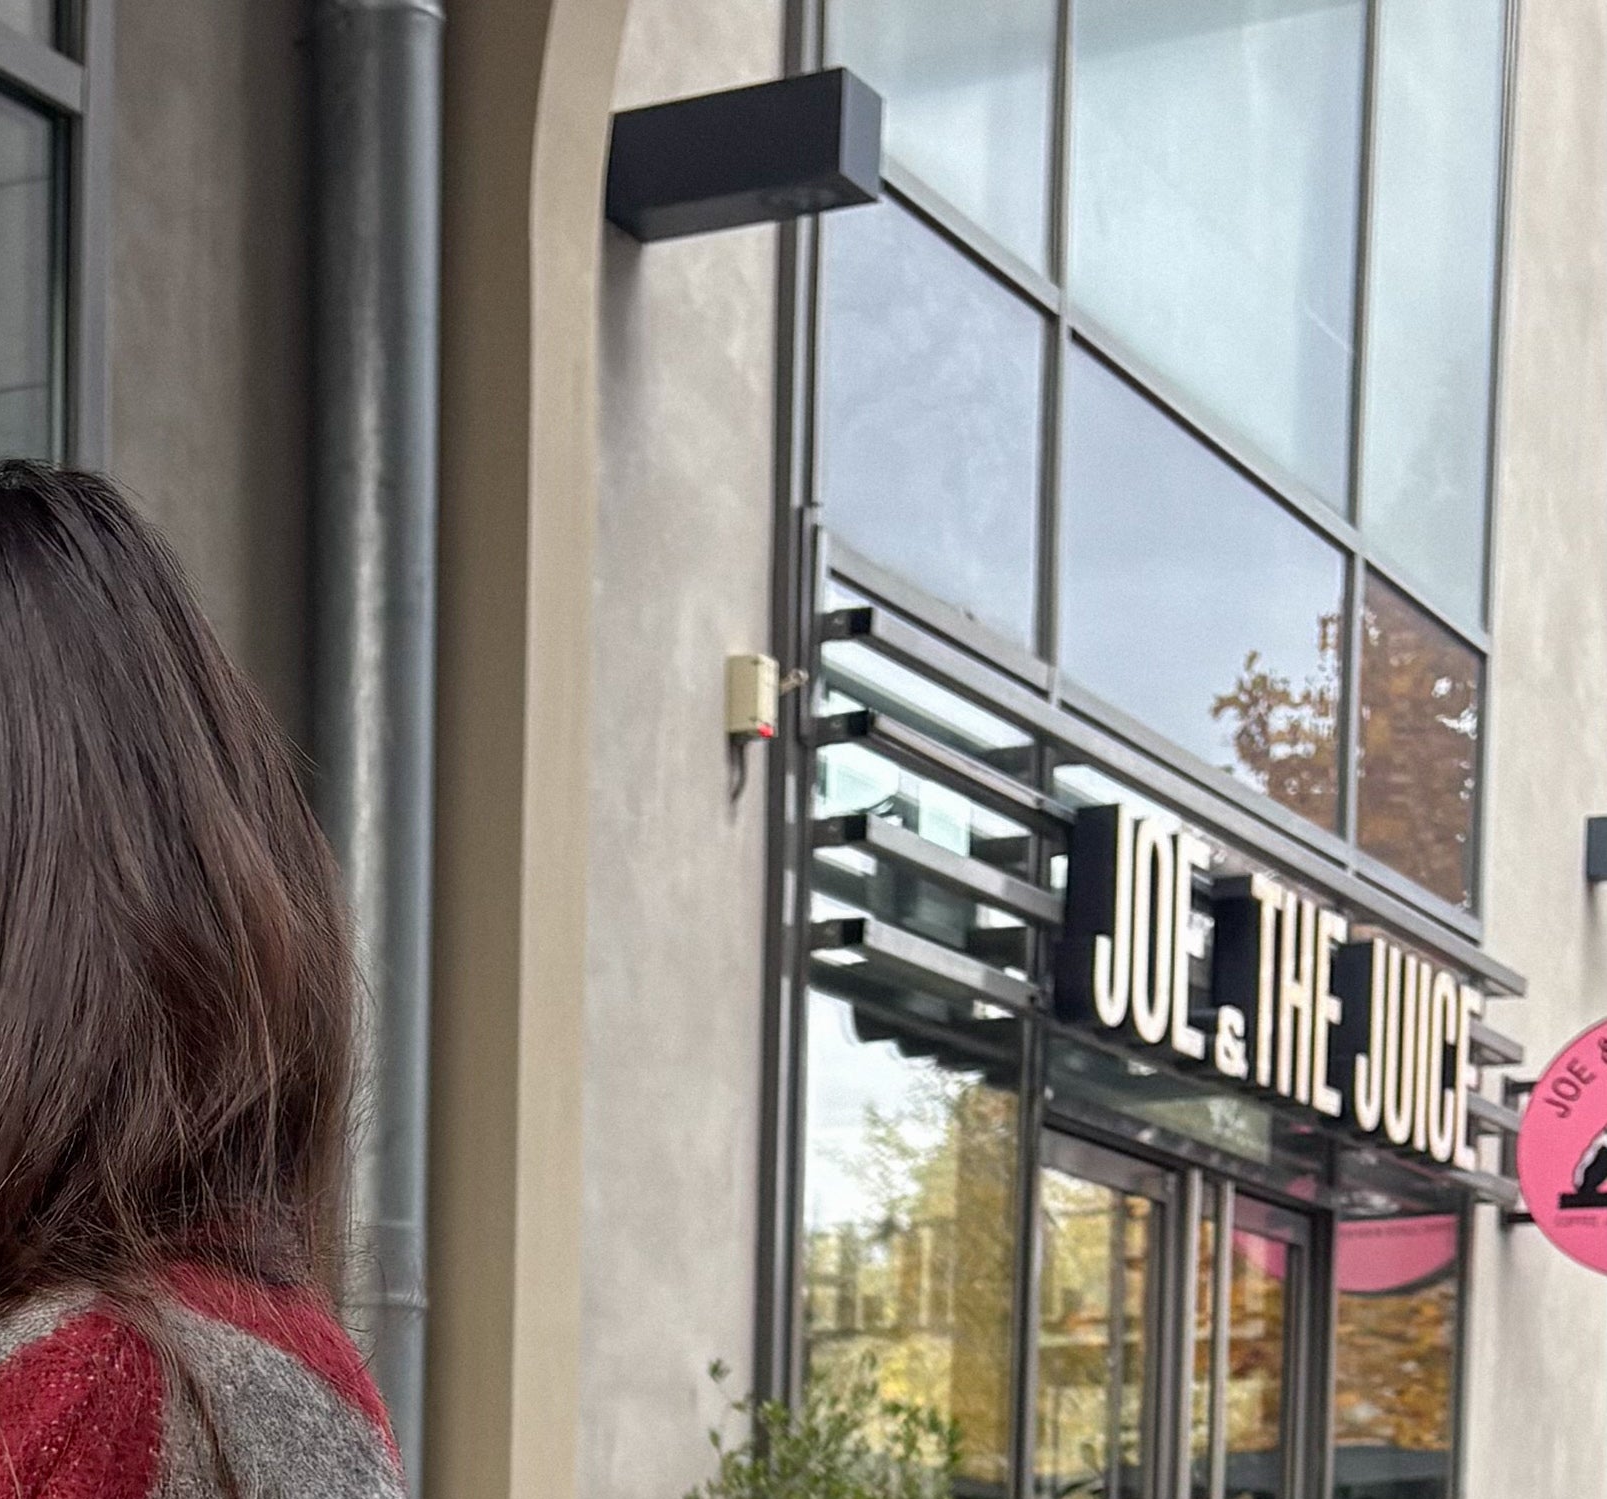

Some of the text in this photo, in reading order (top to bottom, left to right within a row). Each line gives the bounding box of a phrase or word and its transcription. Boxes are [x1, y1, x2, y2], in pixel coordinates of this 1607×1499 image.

[1094, 803, 1484, 1171] JOE & THE JUICE
[1545, 1057, 1596, 1119] JOE
